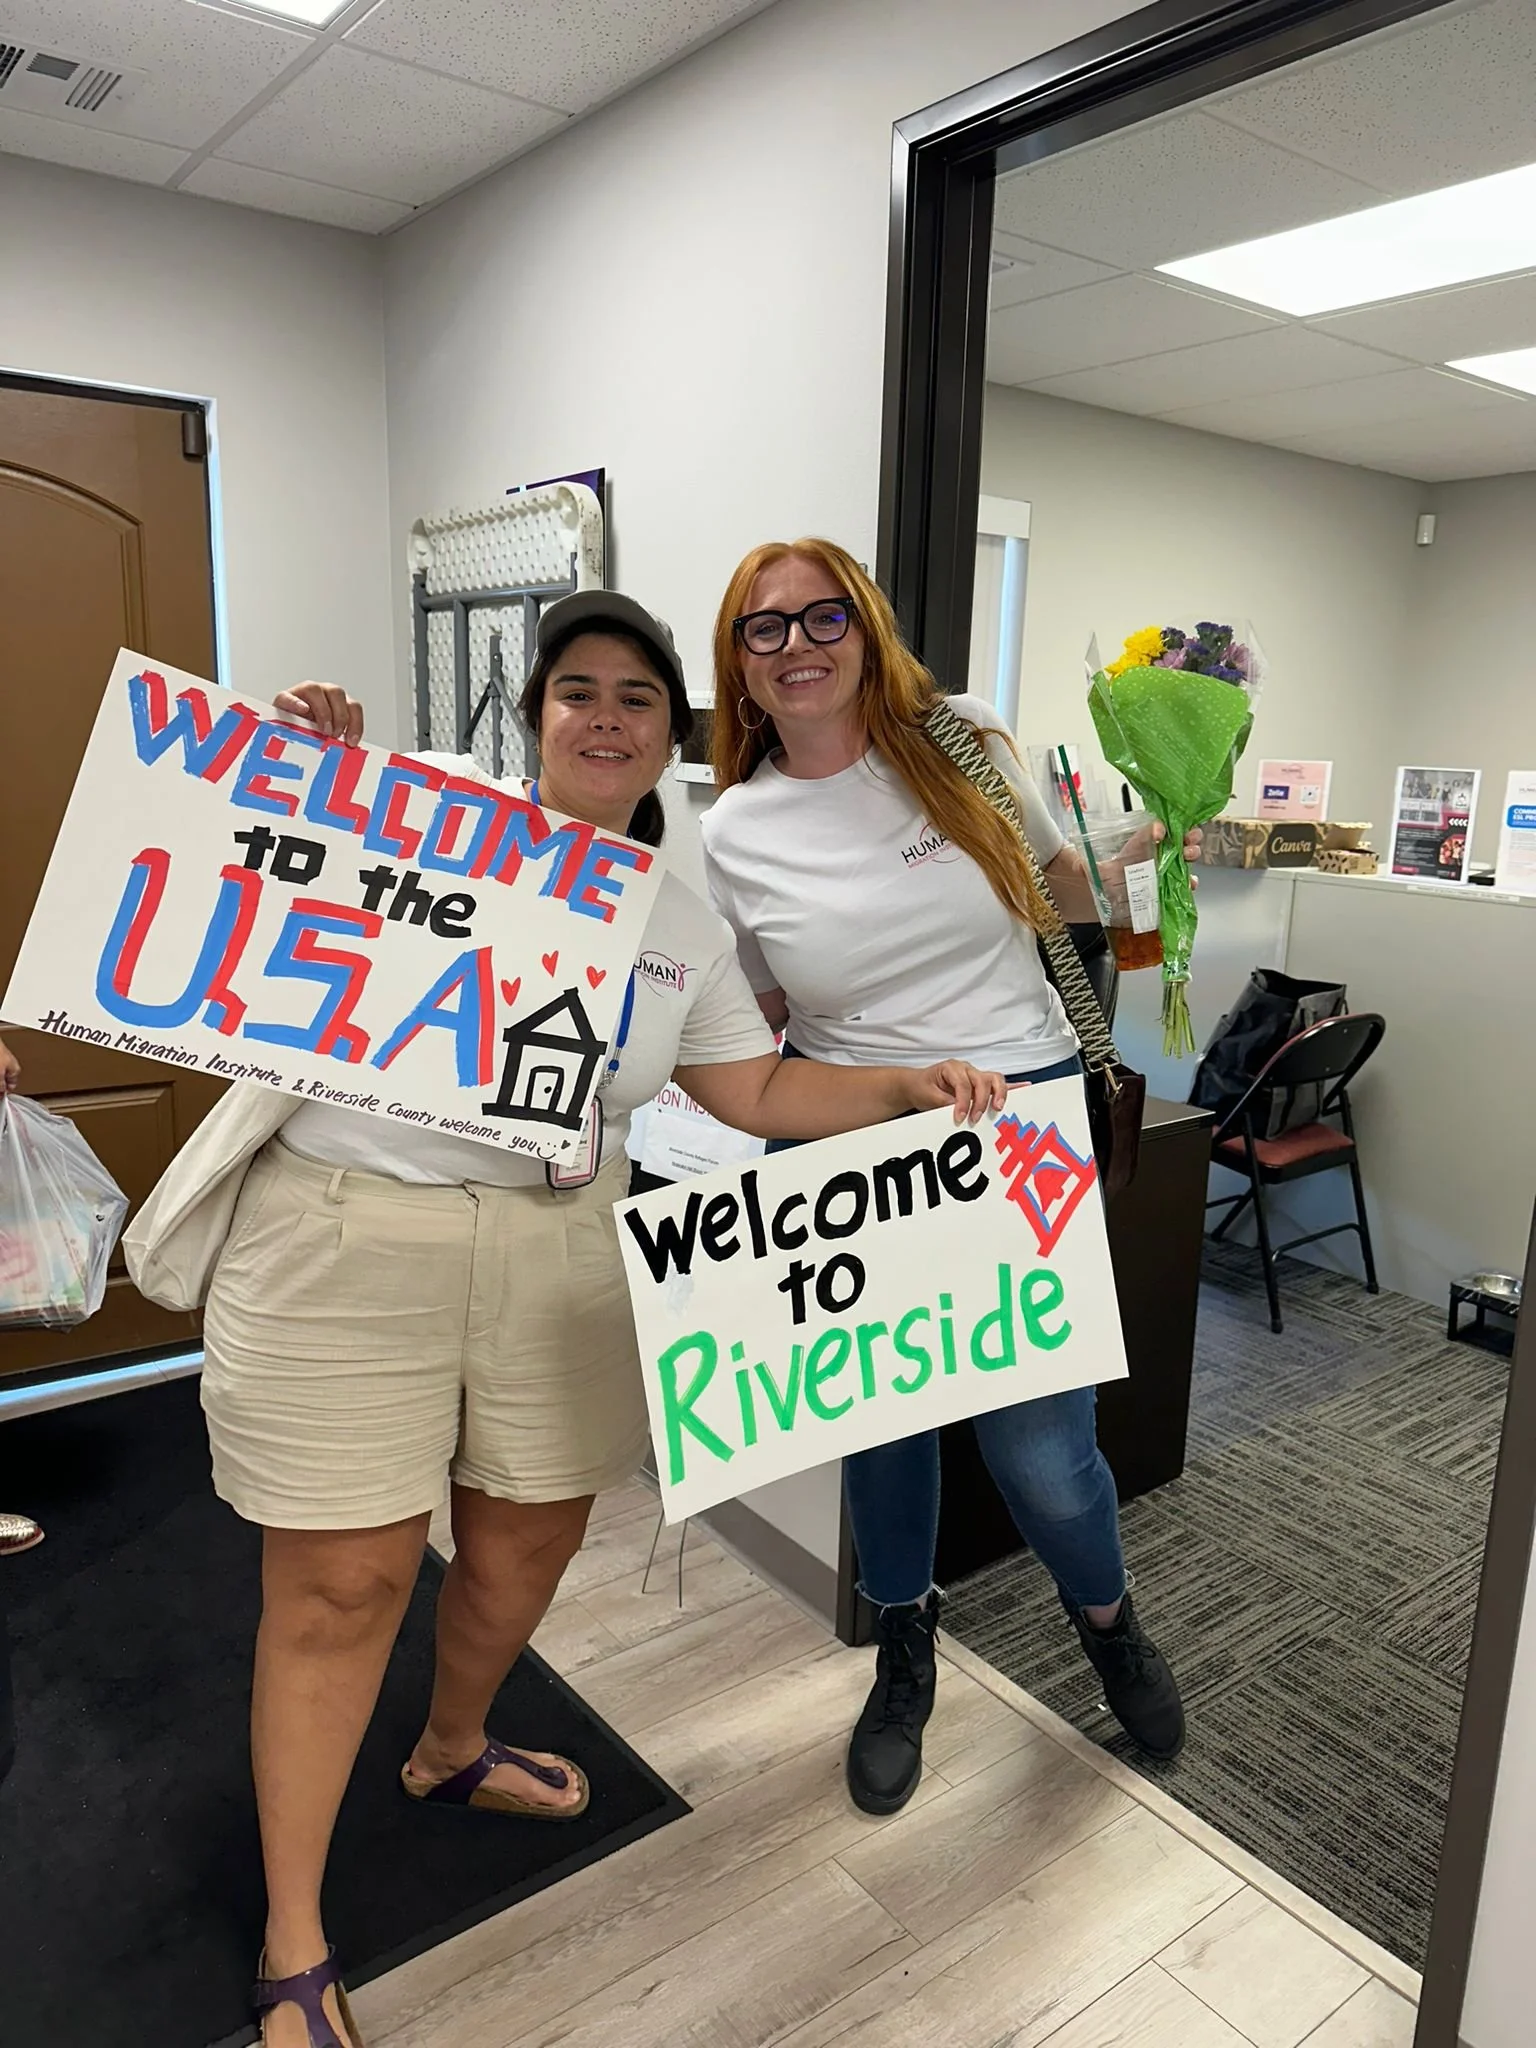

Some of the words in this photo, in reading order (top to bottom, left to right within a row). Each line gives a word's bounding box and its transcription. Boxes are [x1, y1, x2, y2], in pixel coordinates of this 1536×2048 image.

[127, 669, 654, 923] WELCOME
[901, 833, 950, 863] HUMA
[1271, 837, 1312, 854] Canva
[233, 825, 327, 886] to
[357, 864, 478, 939] the
[38, 1010, 112, 1046] Human
[114, 1032, 199, 1066] Migration
[205, 1053, 283, 1086] Institute
[292, 1078, 304, 1092] &
[307, 1080, 380, 1112] Riverside
[386, 1102, 436, 1127] County
[439, 1118, 502, 1141] welcome
[507, 1135, 538, 1153] you
[623, 1130, 990, 1284] Welcome
[777, 1252, 866, 1326] to
[656, 1263, 1073, 1487] Riverside
